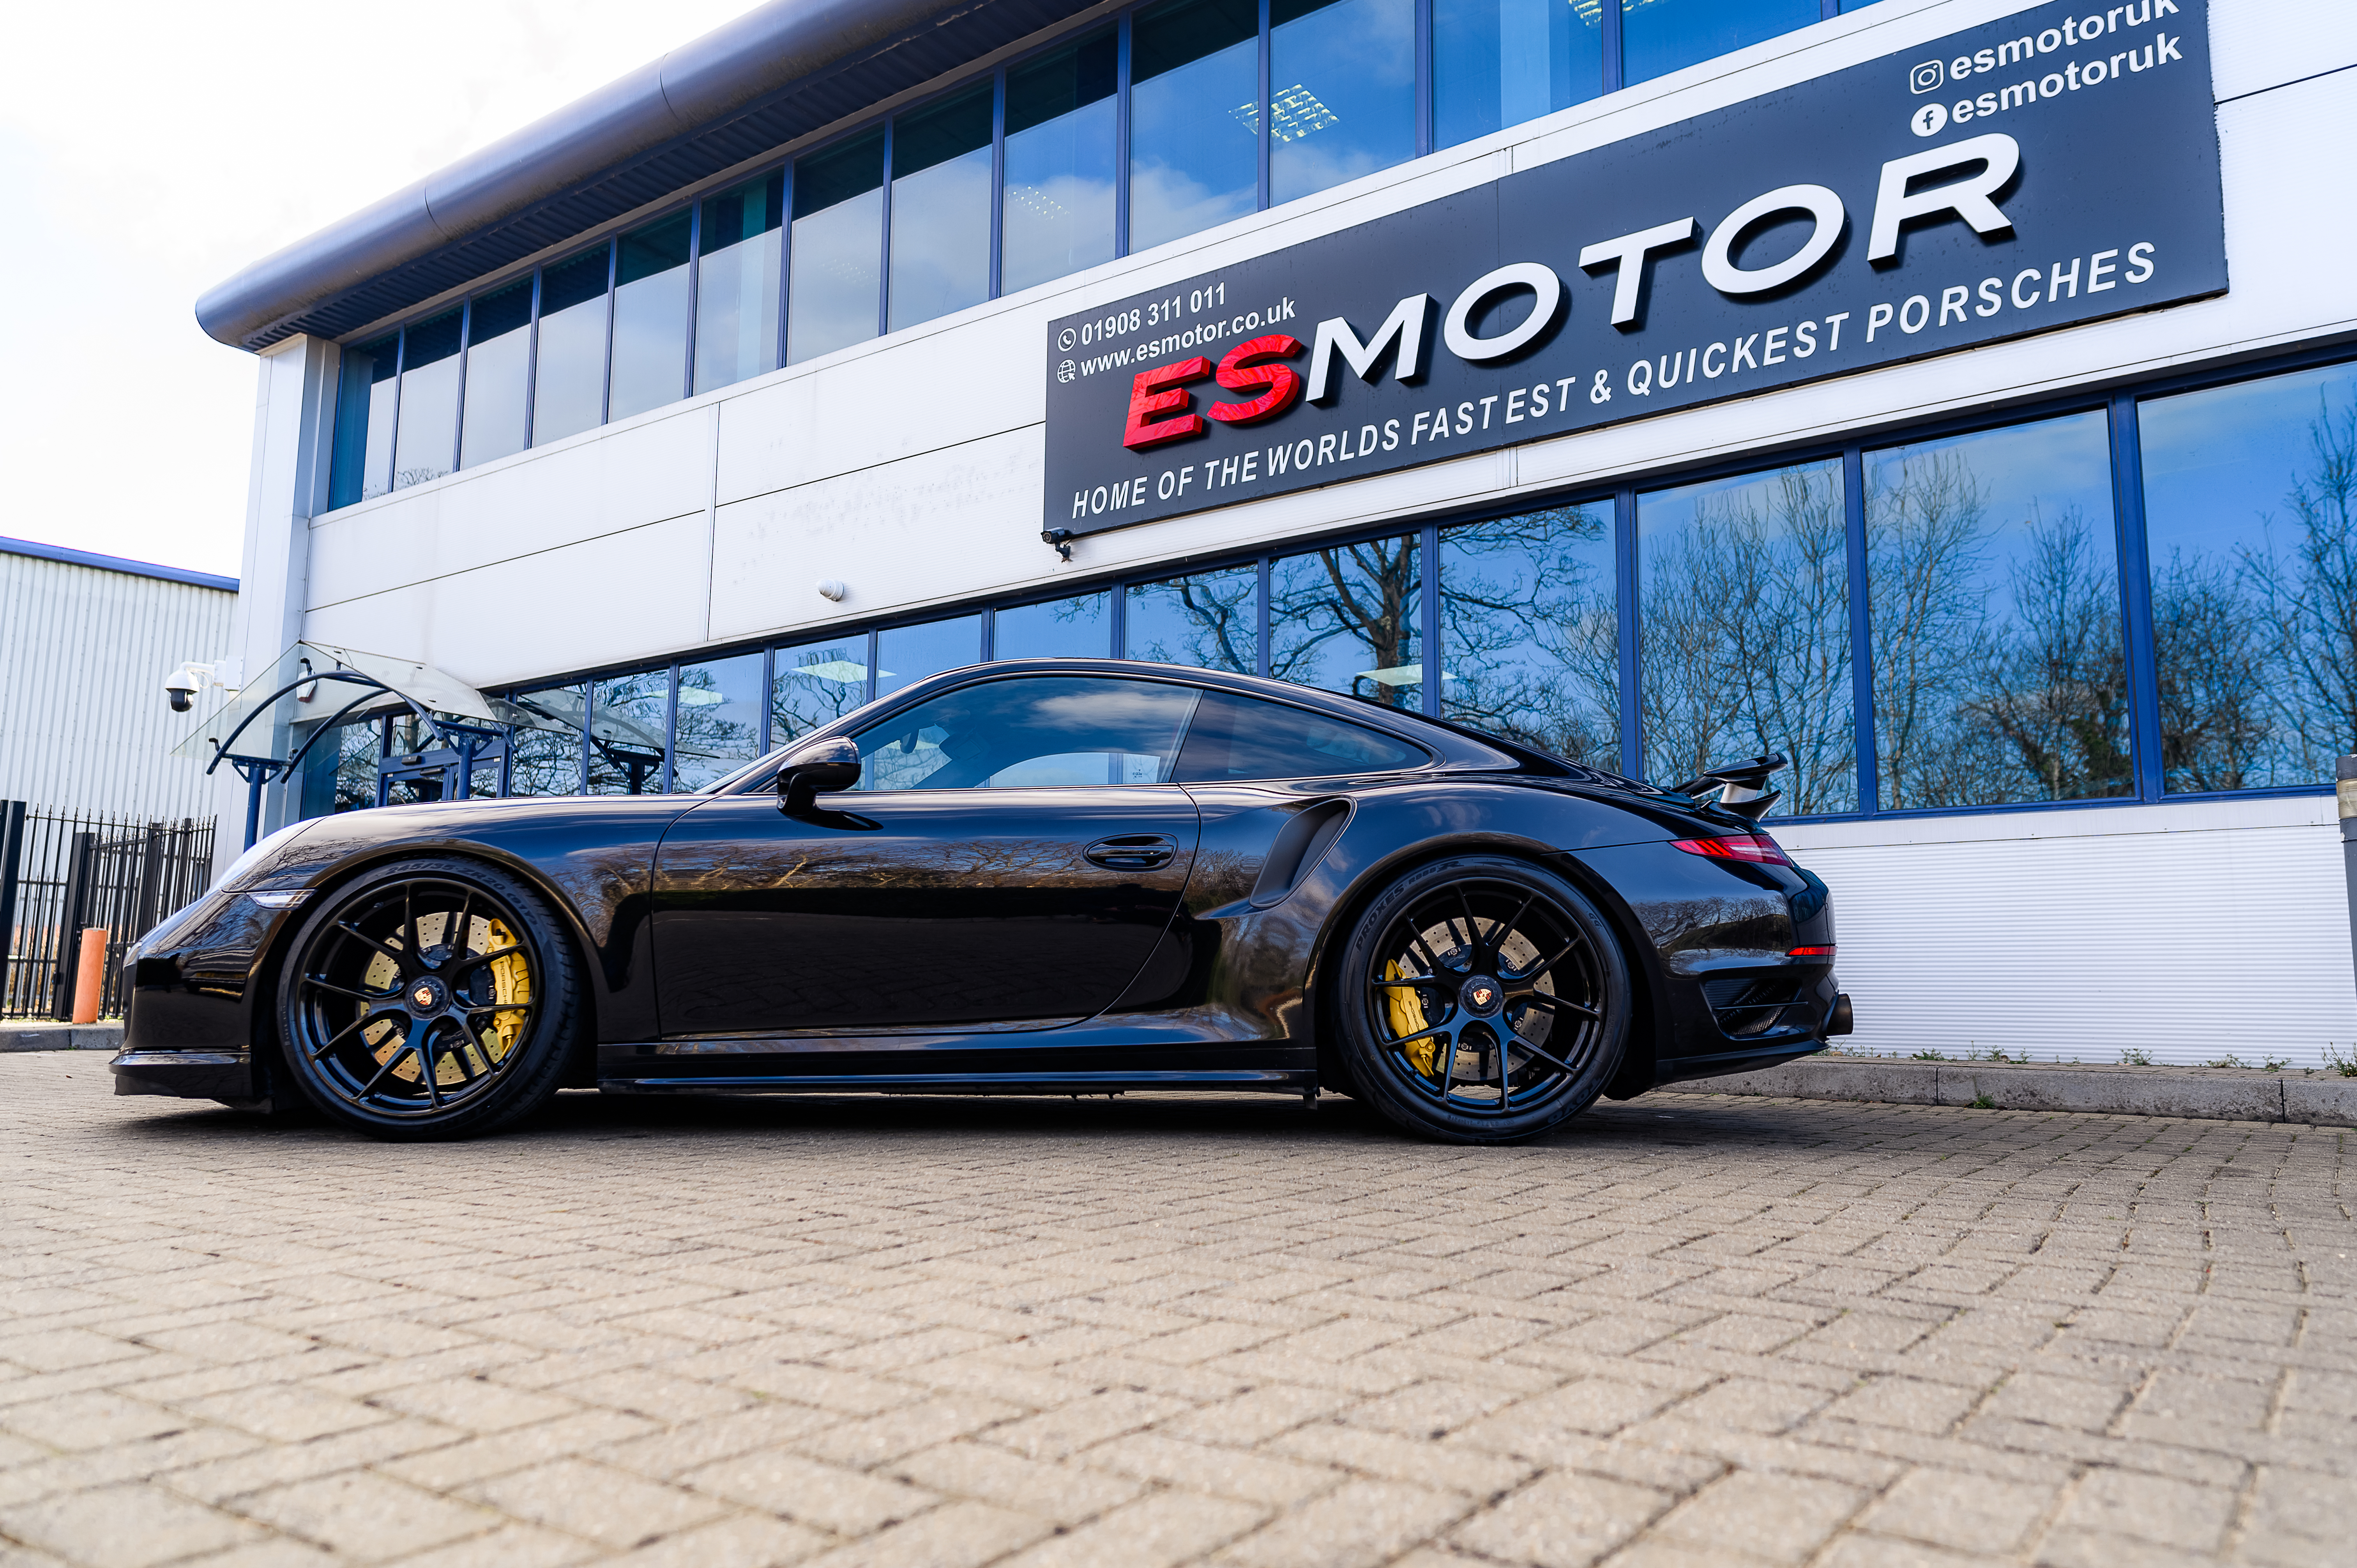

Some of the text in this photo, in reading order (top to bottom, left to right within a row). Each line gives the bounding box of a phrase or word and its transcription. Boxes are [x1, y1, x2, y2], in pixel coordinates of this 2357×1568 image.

[1952, 32, 2183, 124] esmotoruk
[1081, 282, 1224, 346] 01908 311 011
[1122, 132, 2020, 451] ESMOTOR
[1080, 296, 1296, 377] www.esmotor.co.uk
[1072, 242, 2155, 519] HOME OF THE WORLDS FASTEST & QUICKEST PORSCHES
[1355, 884, 1405, 952] PROXES
[1548, 1077, 1601, 1123] TOYO
